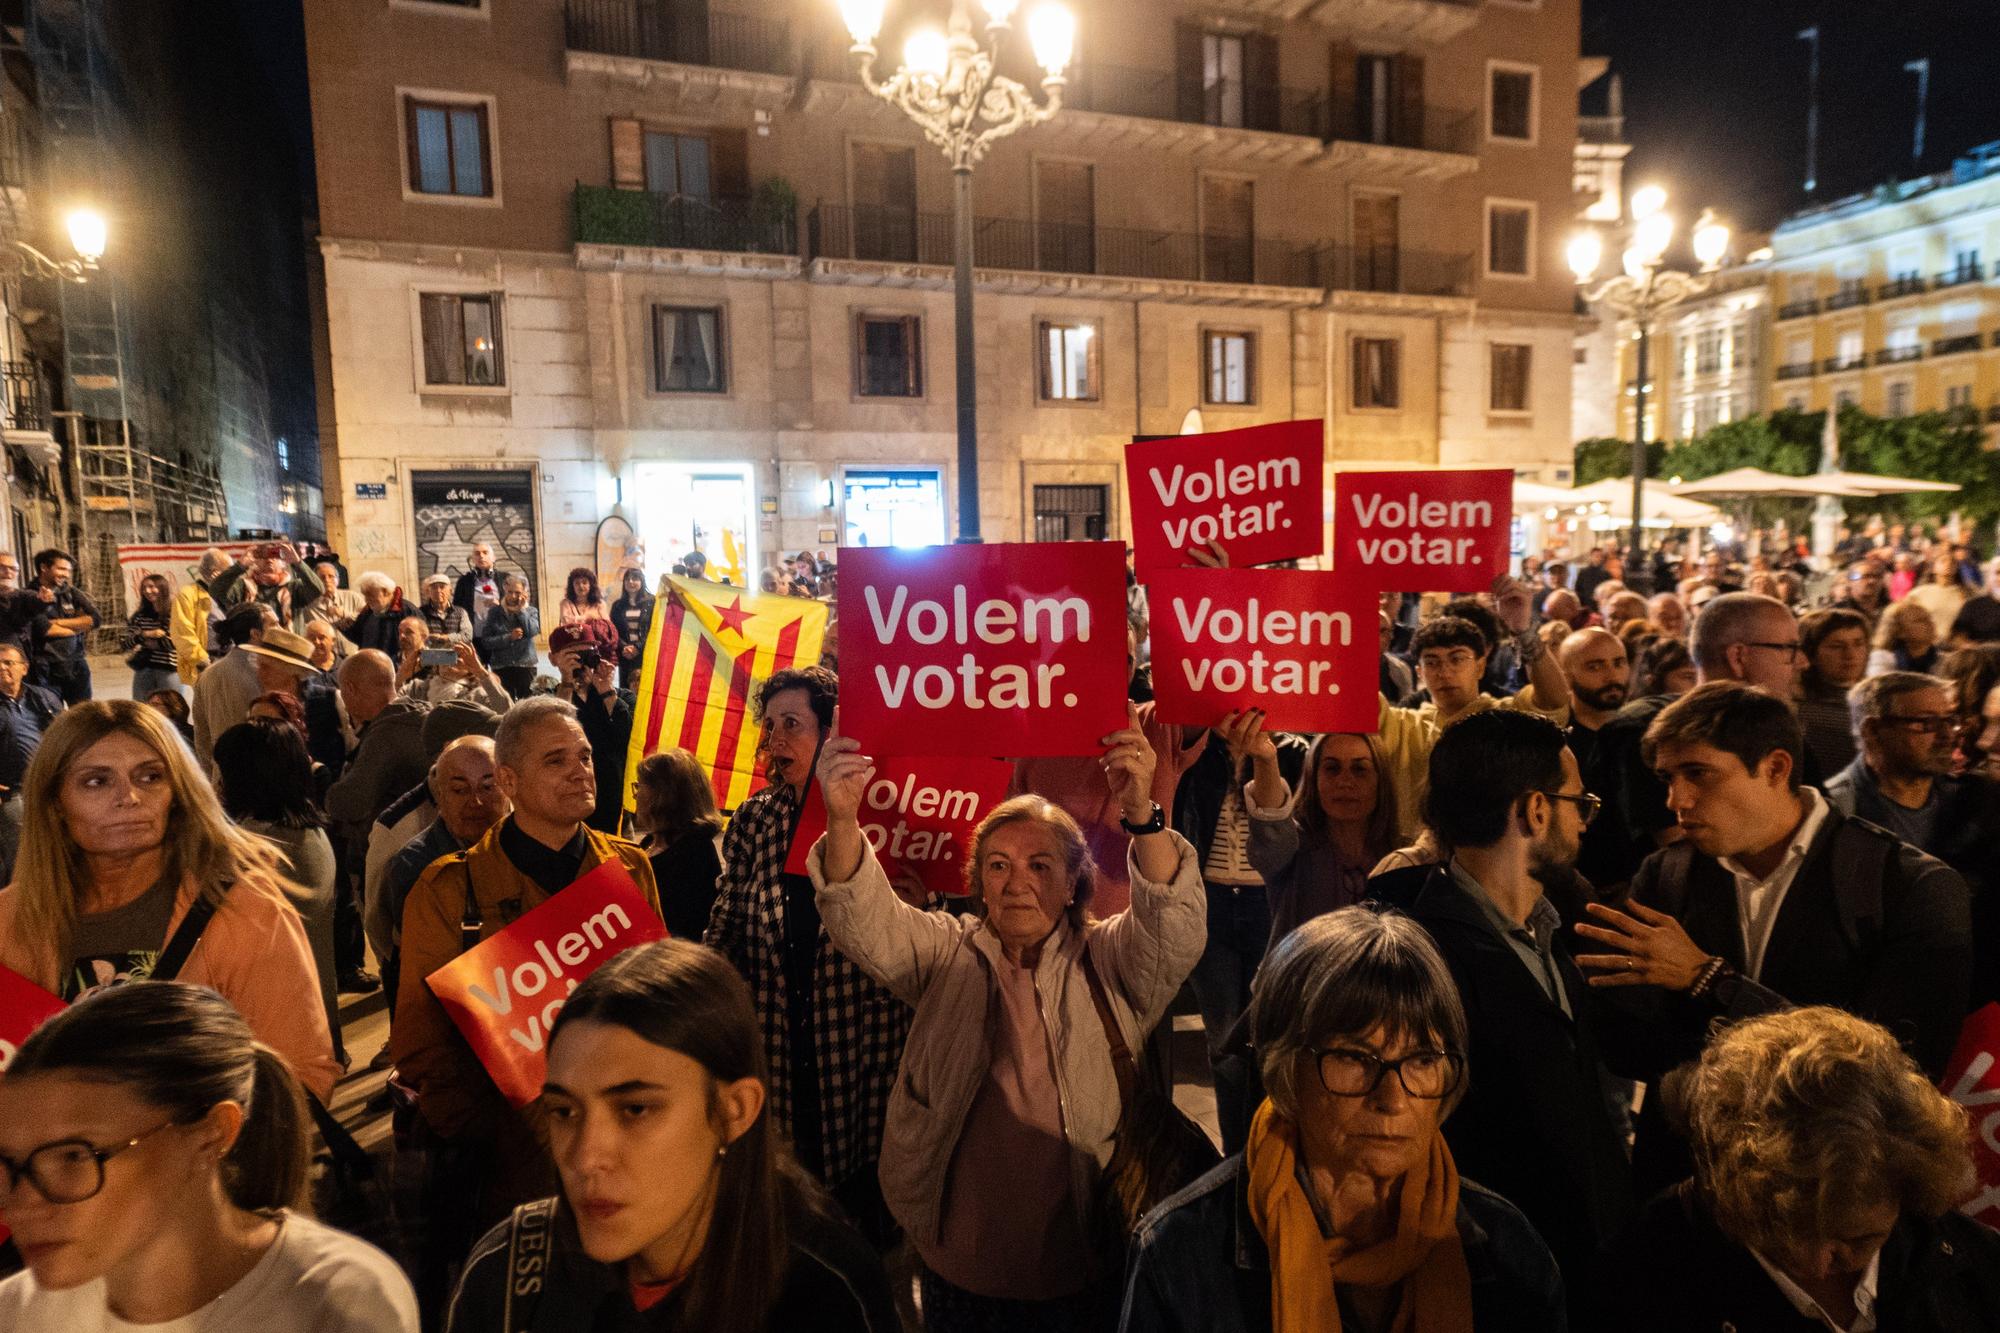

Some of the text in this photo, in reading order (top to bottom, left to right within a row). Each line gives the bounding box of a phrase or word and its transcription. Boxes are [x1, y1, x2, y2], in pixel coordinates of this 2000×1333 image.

[1149, 456, 1301, 507] Volem
[1162, 498, 1292, 548] votar.
[1352, 493, 1492, 528] Volem
[1357, 531, 1482, 565] votar.
[864, 584, 1090, 645] Volem
[1173, 597, 1352, 646] Volem
[875, 652, 1078, 709] votar.
[1183, 650, 1340, 695] votar.
[861, 820, 953, 861] otar.
[467, 902, 633, 1016] Volem
